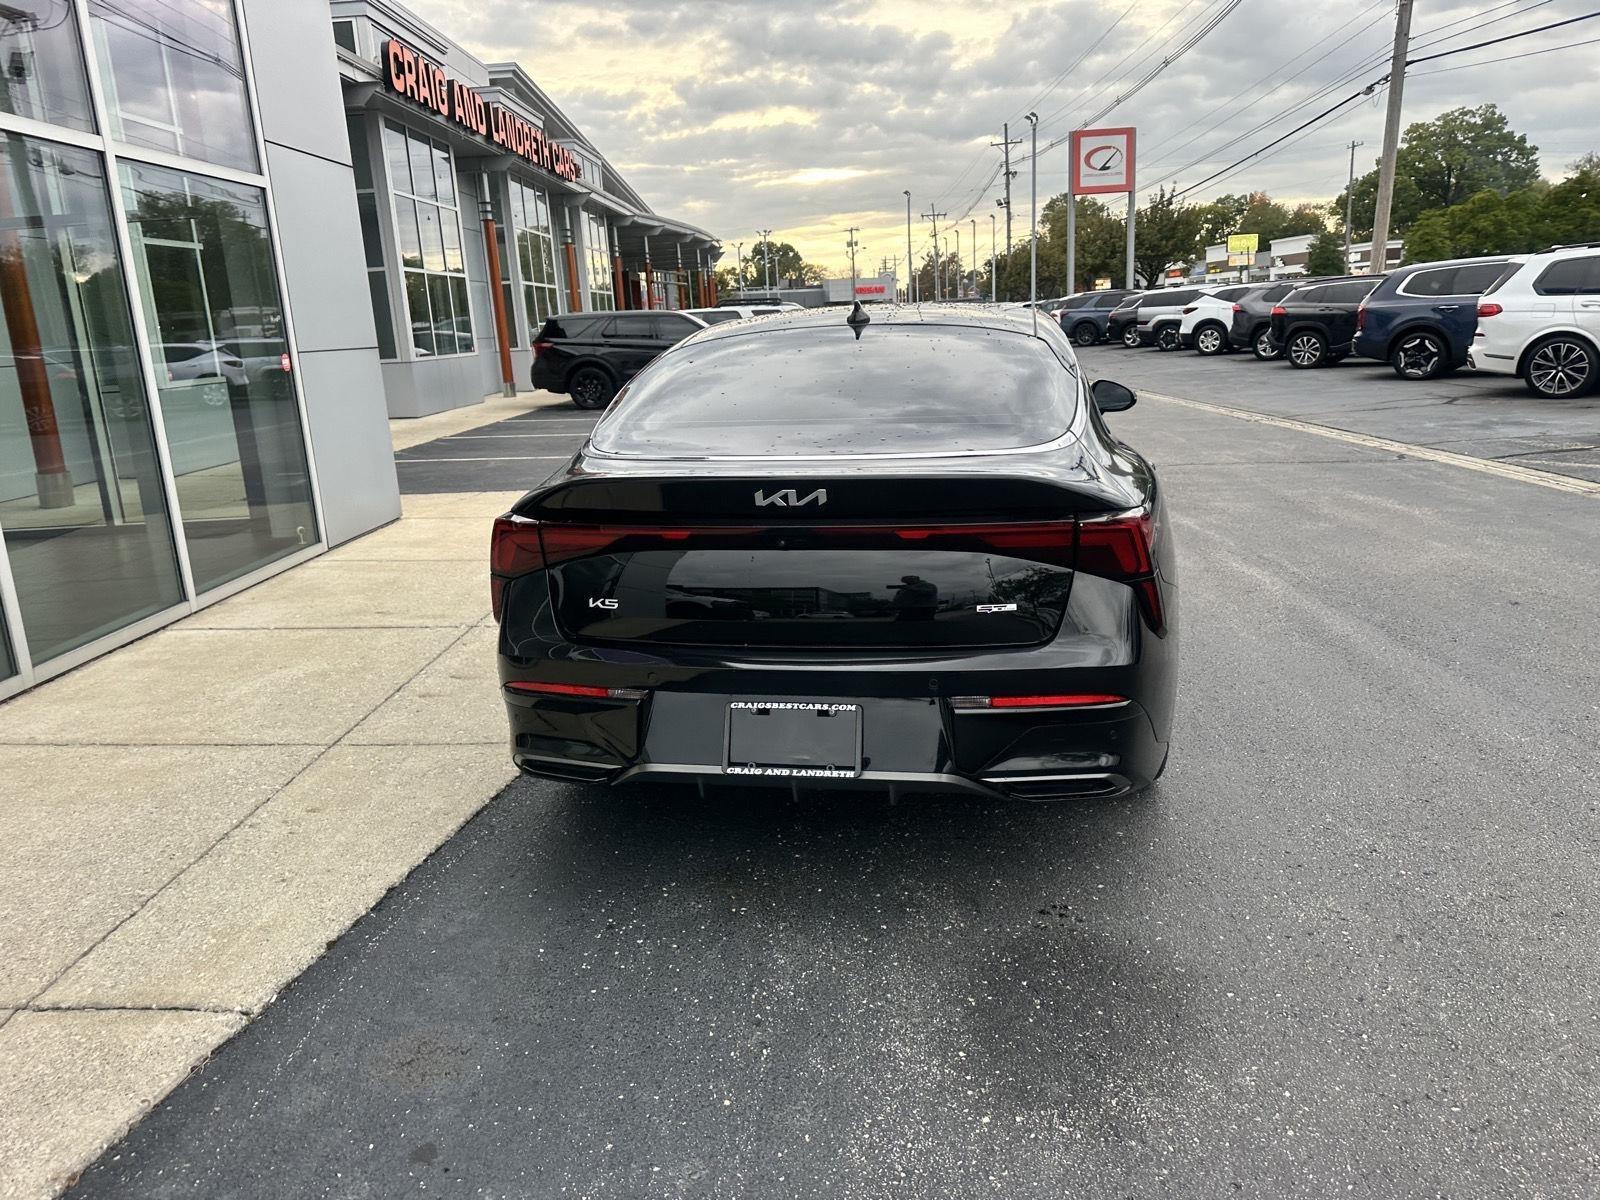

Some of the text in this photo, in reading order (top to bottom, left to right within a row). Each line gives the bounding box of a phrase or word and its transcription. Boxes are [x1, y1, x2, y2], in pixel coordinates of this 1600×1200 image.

[386, 38, 576, 182] CRAIG AND LANDRETH CARS
[754, 488, 828, 507] KIA
[588, 597, 619, 610] K5
[730, 702, 857, 711] CRAIGSBESTCARS.COM
[726, 767, 856, 778] CRAIG AND LANDRETH
